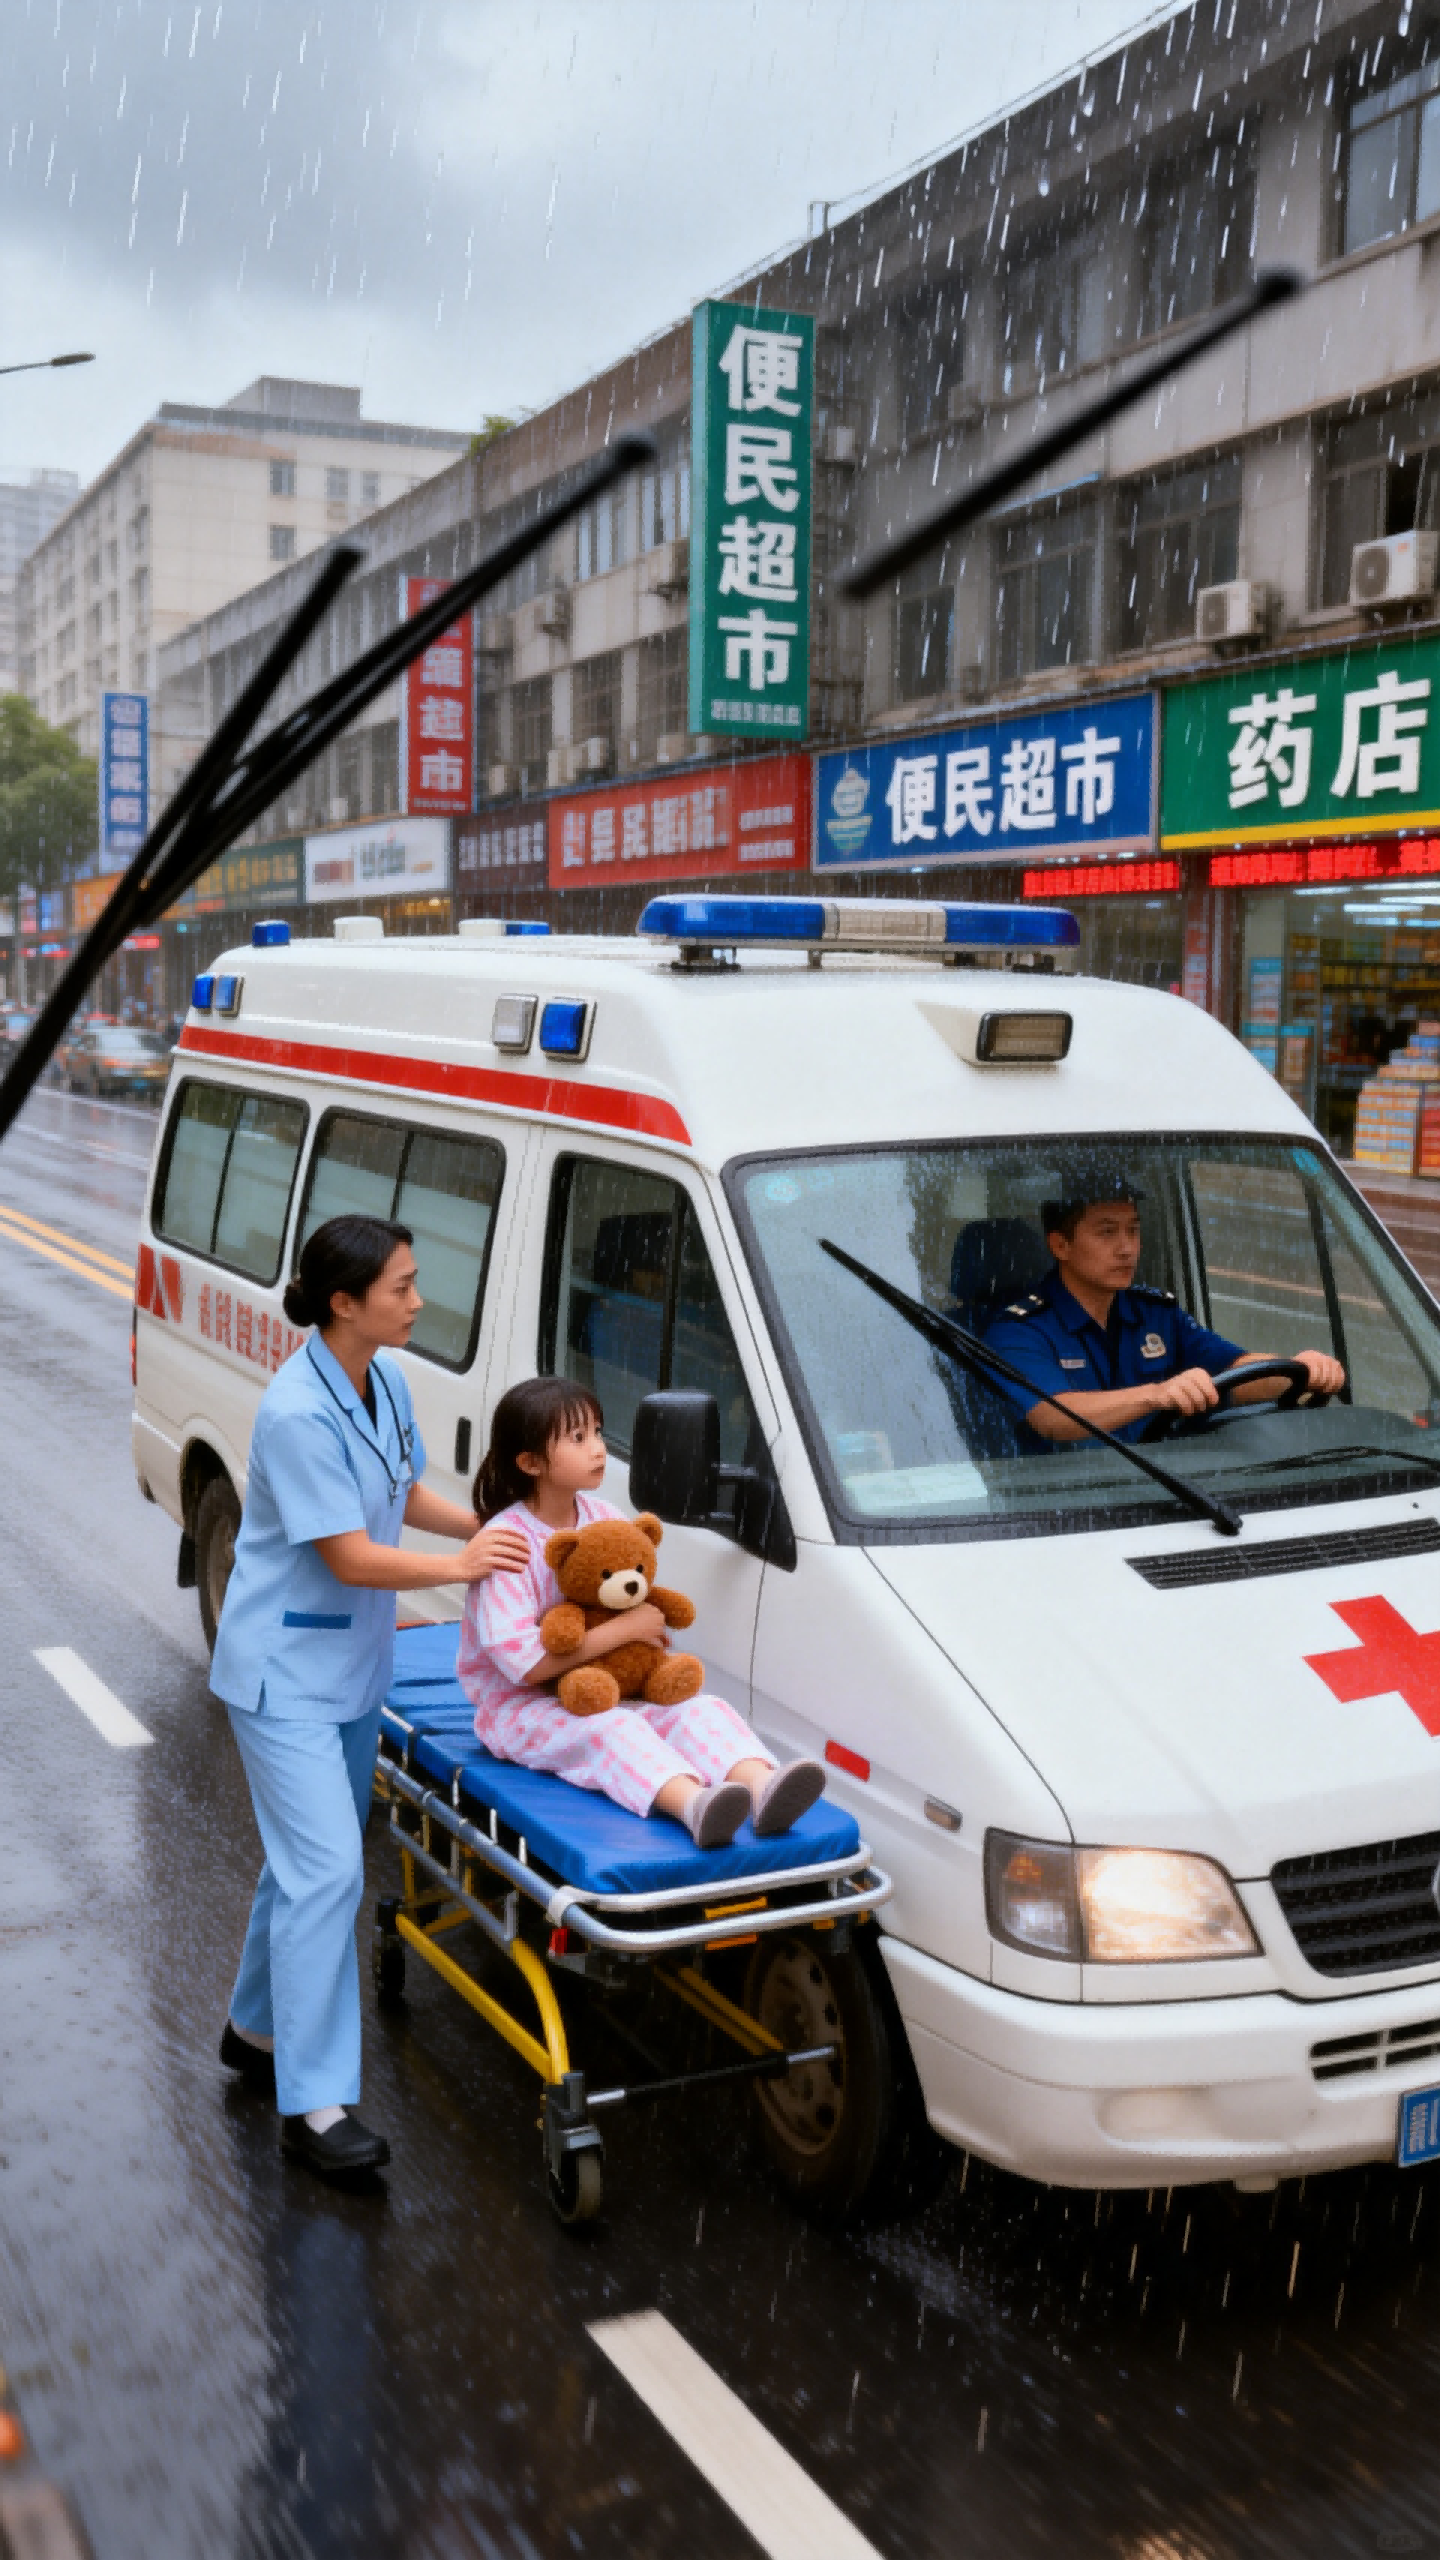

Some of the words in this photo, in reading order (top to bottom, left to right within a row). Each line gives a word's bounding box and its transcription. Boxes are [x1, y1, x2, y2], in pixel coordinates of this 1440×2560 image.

[718, 324, 803, 691] 便民超市
[885, 726, 1121, 844] 便民超市
[1228, 671, 1431, 809] 药店
